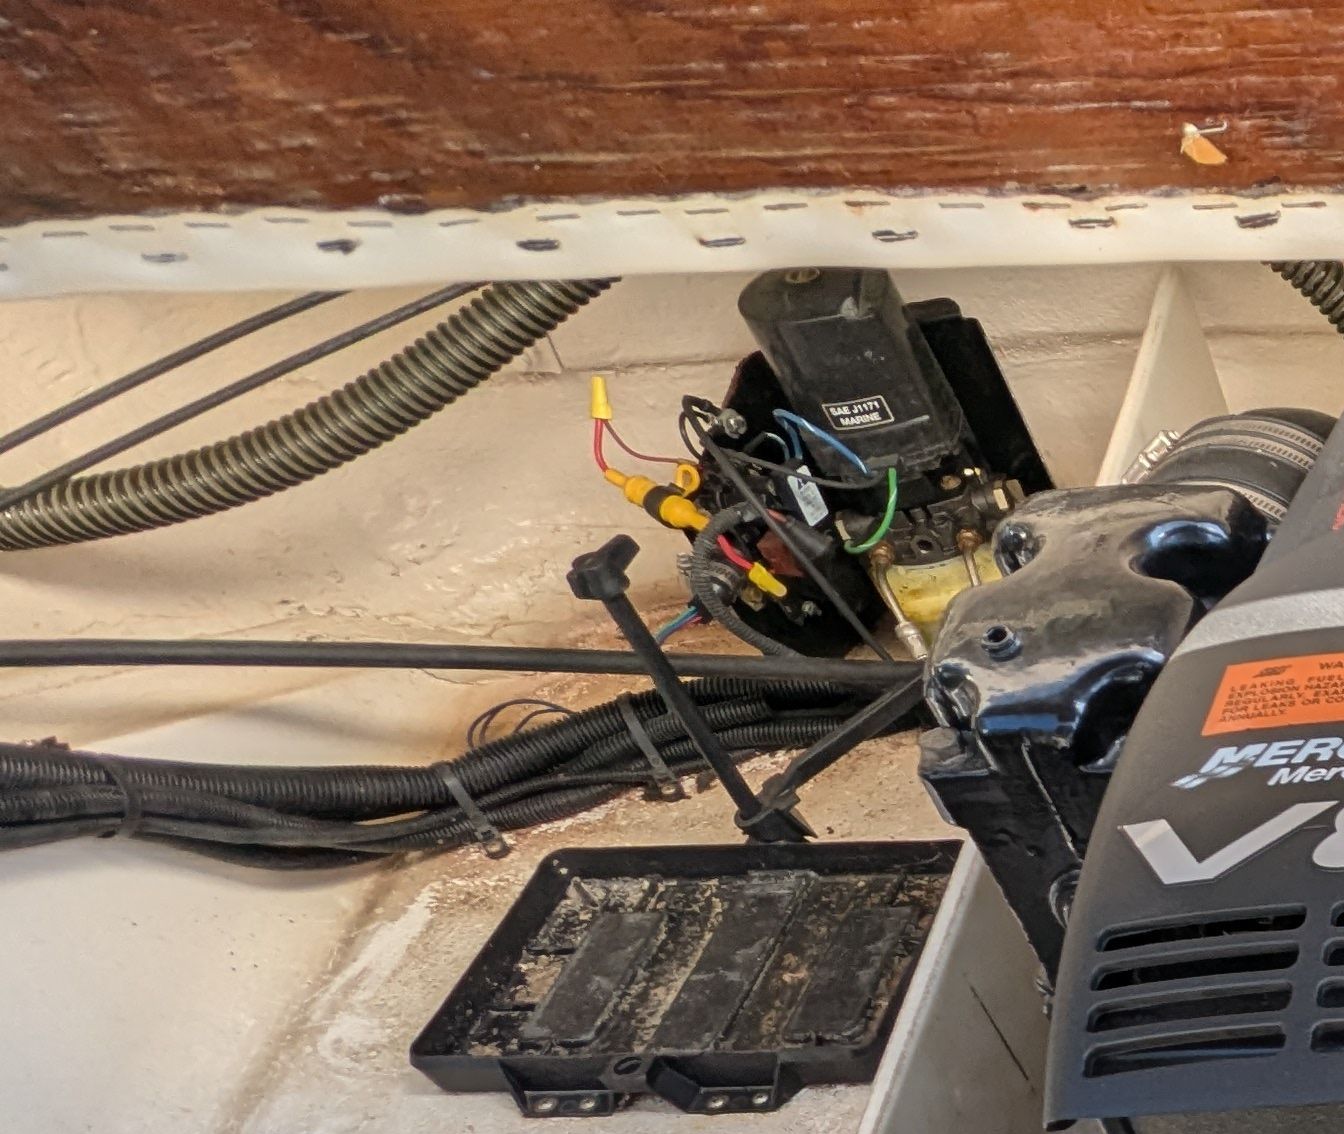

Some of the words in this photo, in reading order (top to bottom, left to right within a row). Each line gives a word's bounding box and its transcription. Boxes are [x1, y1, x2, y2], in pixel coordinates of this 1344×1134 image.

[839, 412, 882, 426] MARINE
[1230, 679, 1295, 692] LEAKING
[1307, 674, 1344, 682] FUEL
[1253, 700, 1297, 711] LEAKS
